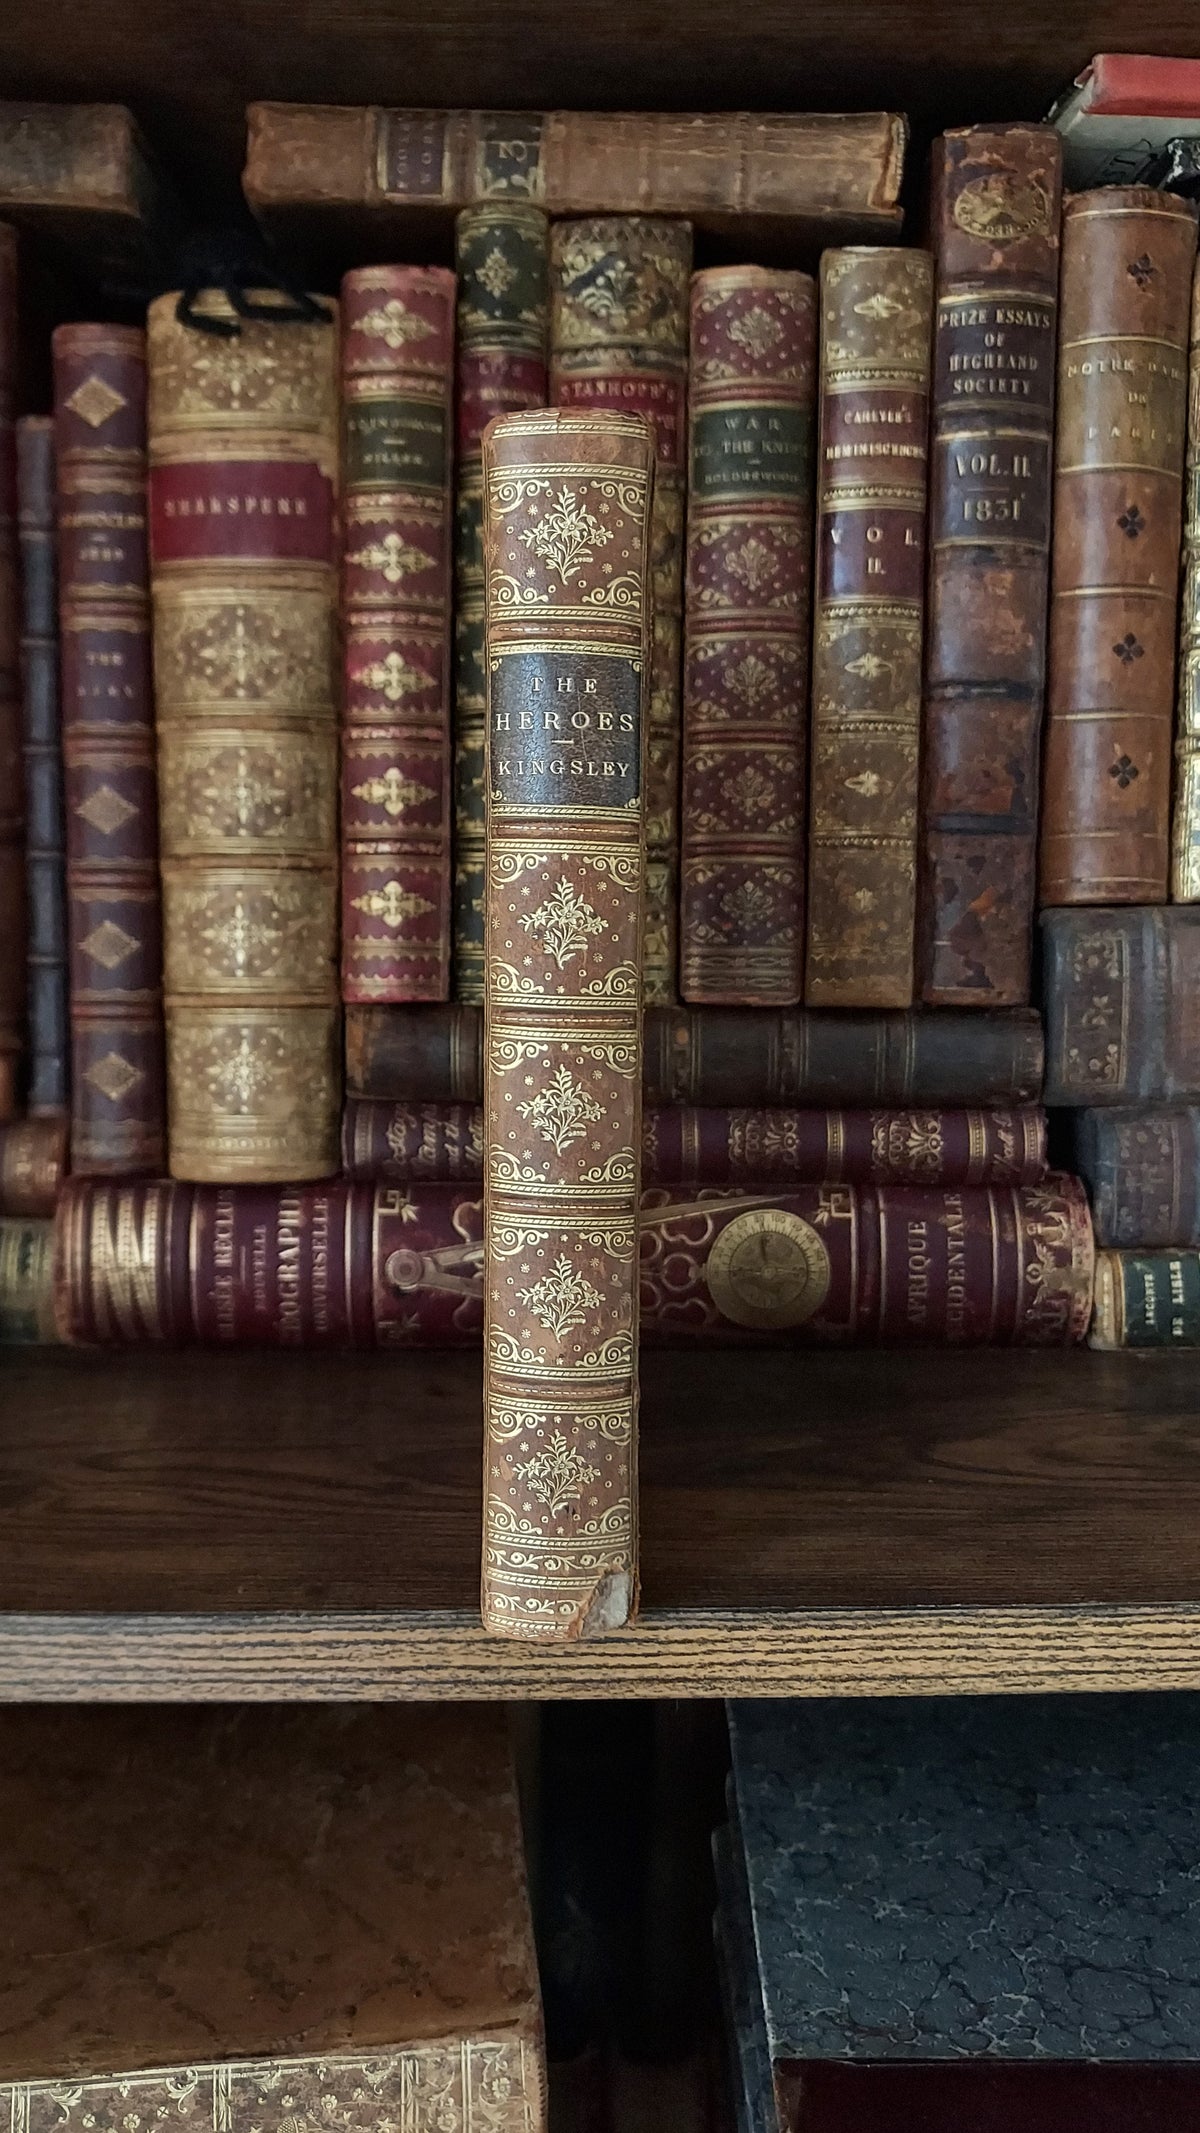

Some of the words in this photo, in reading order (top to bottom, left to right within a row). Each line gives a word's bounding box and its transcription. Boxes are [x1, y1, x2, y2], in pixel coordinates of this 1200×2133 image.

[939, 309, 987, 328] PRIZE
[996, 309, 1050, 328] ESSAYS
[984, 333, 1005, 347] OF
[949, 354, 1038, 371] HIGHLAND
[953, 379, 1031, 395] SOCIETY
[724, 415, 783, 431] WAR
[721, 440, 754, 453] THE
[956, 454, 1009, 478] VOL.
[530, 676, 598, 694] THE
[495, 711, 634, 732] HEROES
[497, 760, 630, 778] KINGSLEY
[275, 1189, 302, 1338] ÉOGRAPHI
[944, 1193, 966, 1332] CIDENTALE
[907, 1221, 931, 1323] AFRIQUE
